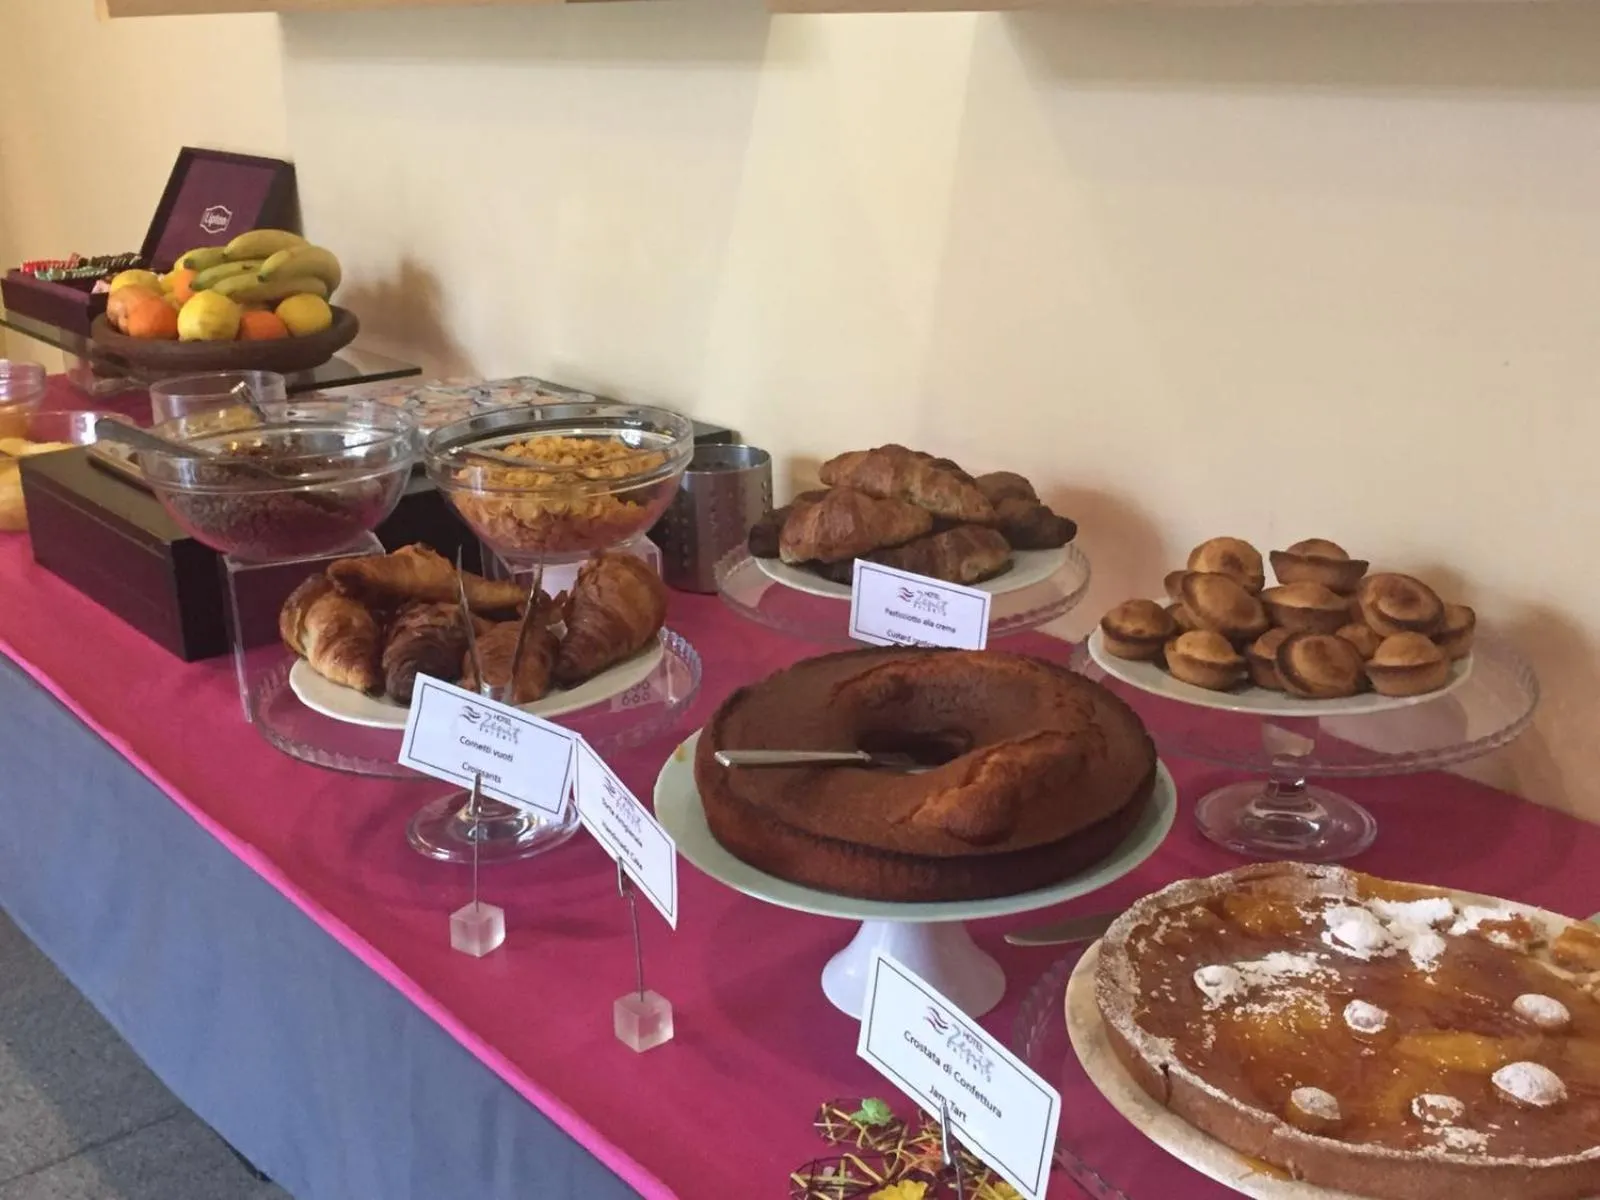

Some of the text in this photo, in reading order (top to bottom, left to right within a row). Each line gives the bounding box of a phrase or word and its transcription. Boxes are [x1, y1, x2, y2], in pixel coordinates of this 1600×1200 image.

[922, 619, 935, 628] alla
[935, 623, 957, 633] crema
[493, 712, 512, 726] HOTEL
[459, 735, 513, 763] Cornetti vuoti
[962, 1030, 985, 1055] HOTEL
[903, 1029, 1003, 1119] Crostata di Confettura
[929, 1085, 967, 1123] Jam Tart
